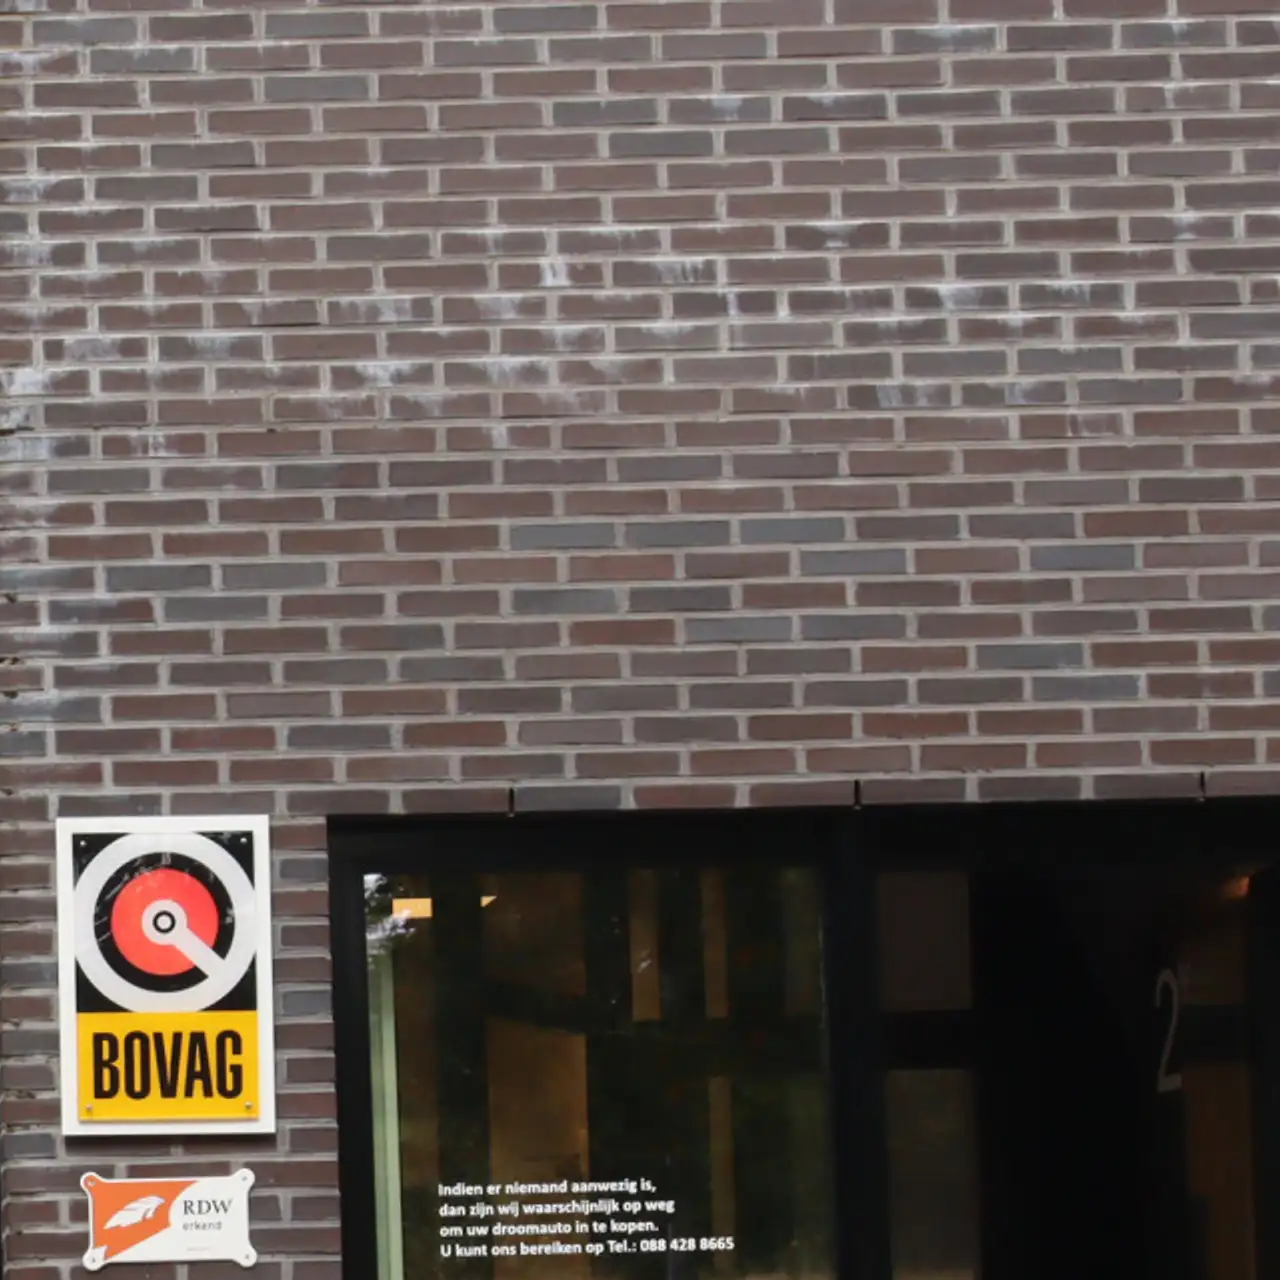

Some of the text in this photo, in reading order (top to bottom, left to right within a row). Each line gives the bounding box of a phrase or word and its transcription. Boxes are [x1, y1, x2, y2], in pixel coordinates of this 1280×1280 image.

[93, 1030, 243, 1100] BOVAG
[438, 1178, 657, 1196] Indien er niemand aanwezig is,
[182, 1199, 233, 1216] RDW
[439, 1199, 676, 1218] dan zijn wij waarschijnlijk op weg
[182, 1219, 223, 1231] erkend
[440, 1219, 659, 1237] om uw droomauto in te kopen.
[440, 1244, 451, 1257] U
[455, 1243, 488, 1257] kunt
[491, 1245, 517, 1256] ons
[520, 1241, 582, 1255] bereiken
[585, 1242, 604, 1256] op
[640, 1239, 667, 1252] 088
[670, 1238, 696, 1251] 428
[700, 1236, 735, 1250] 8665
